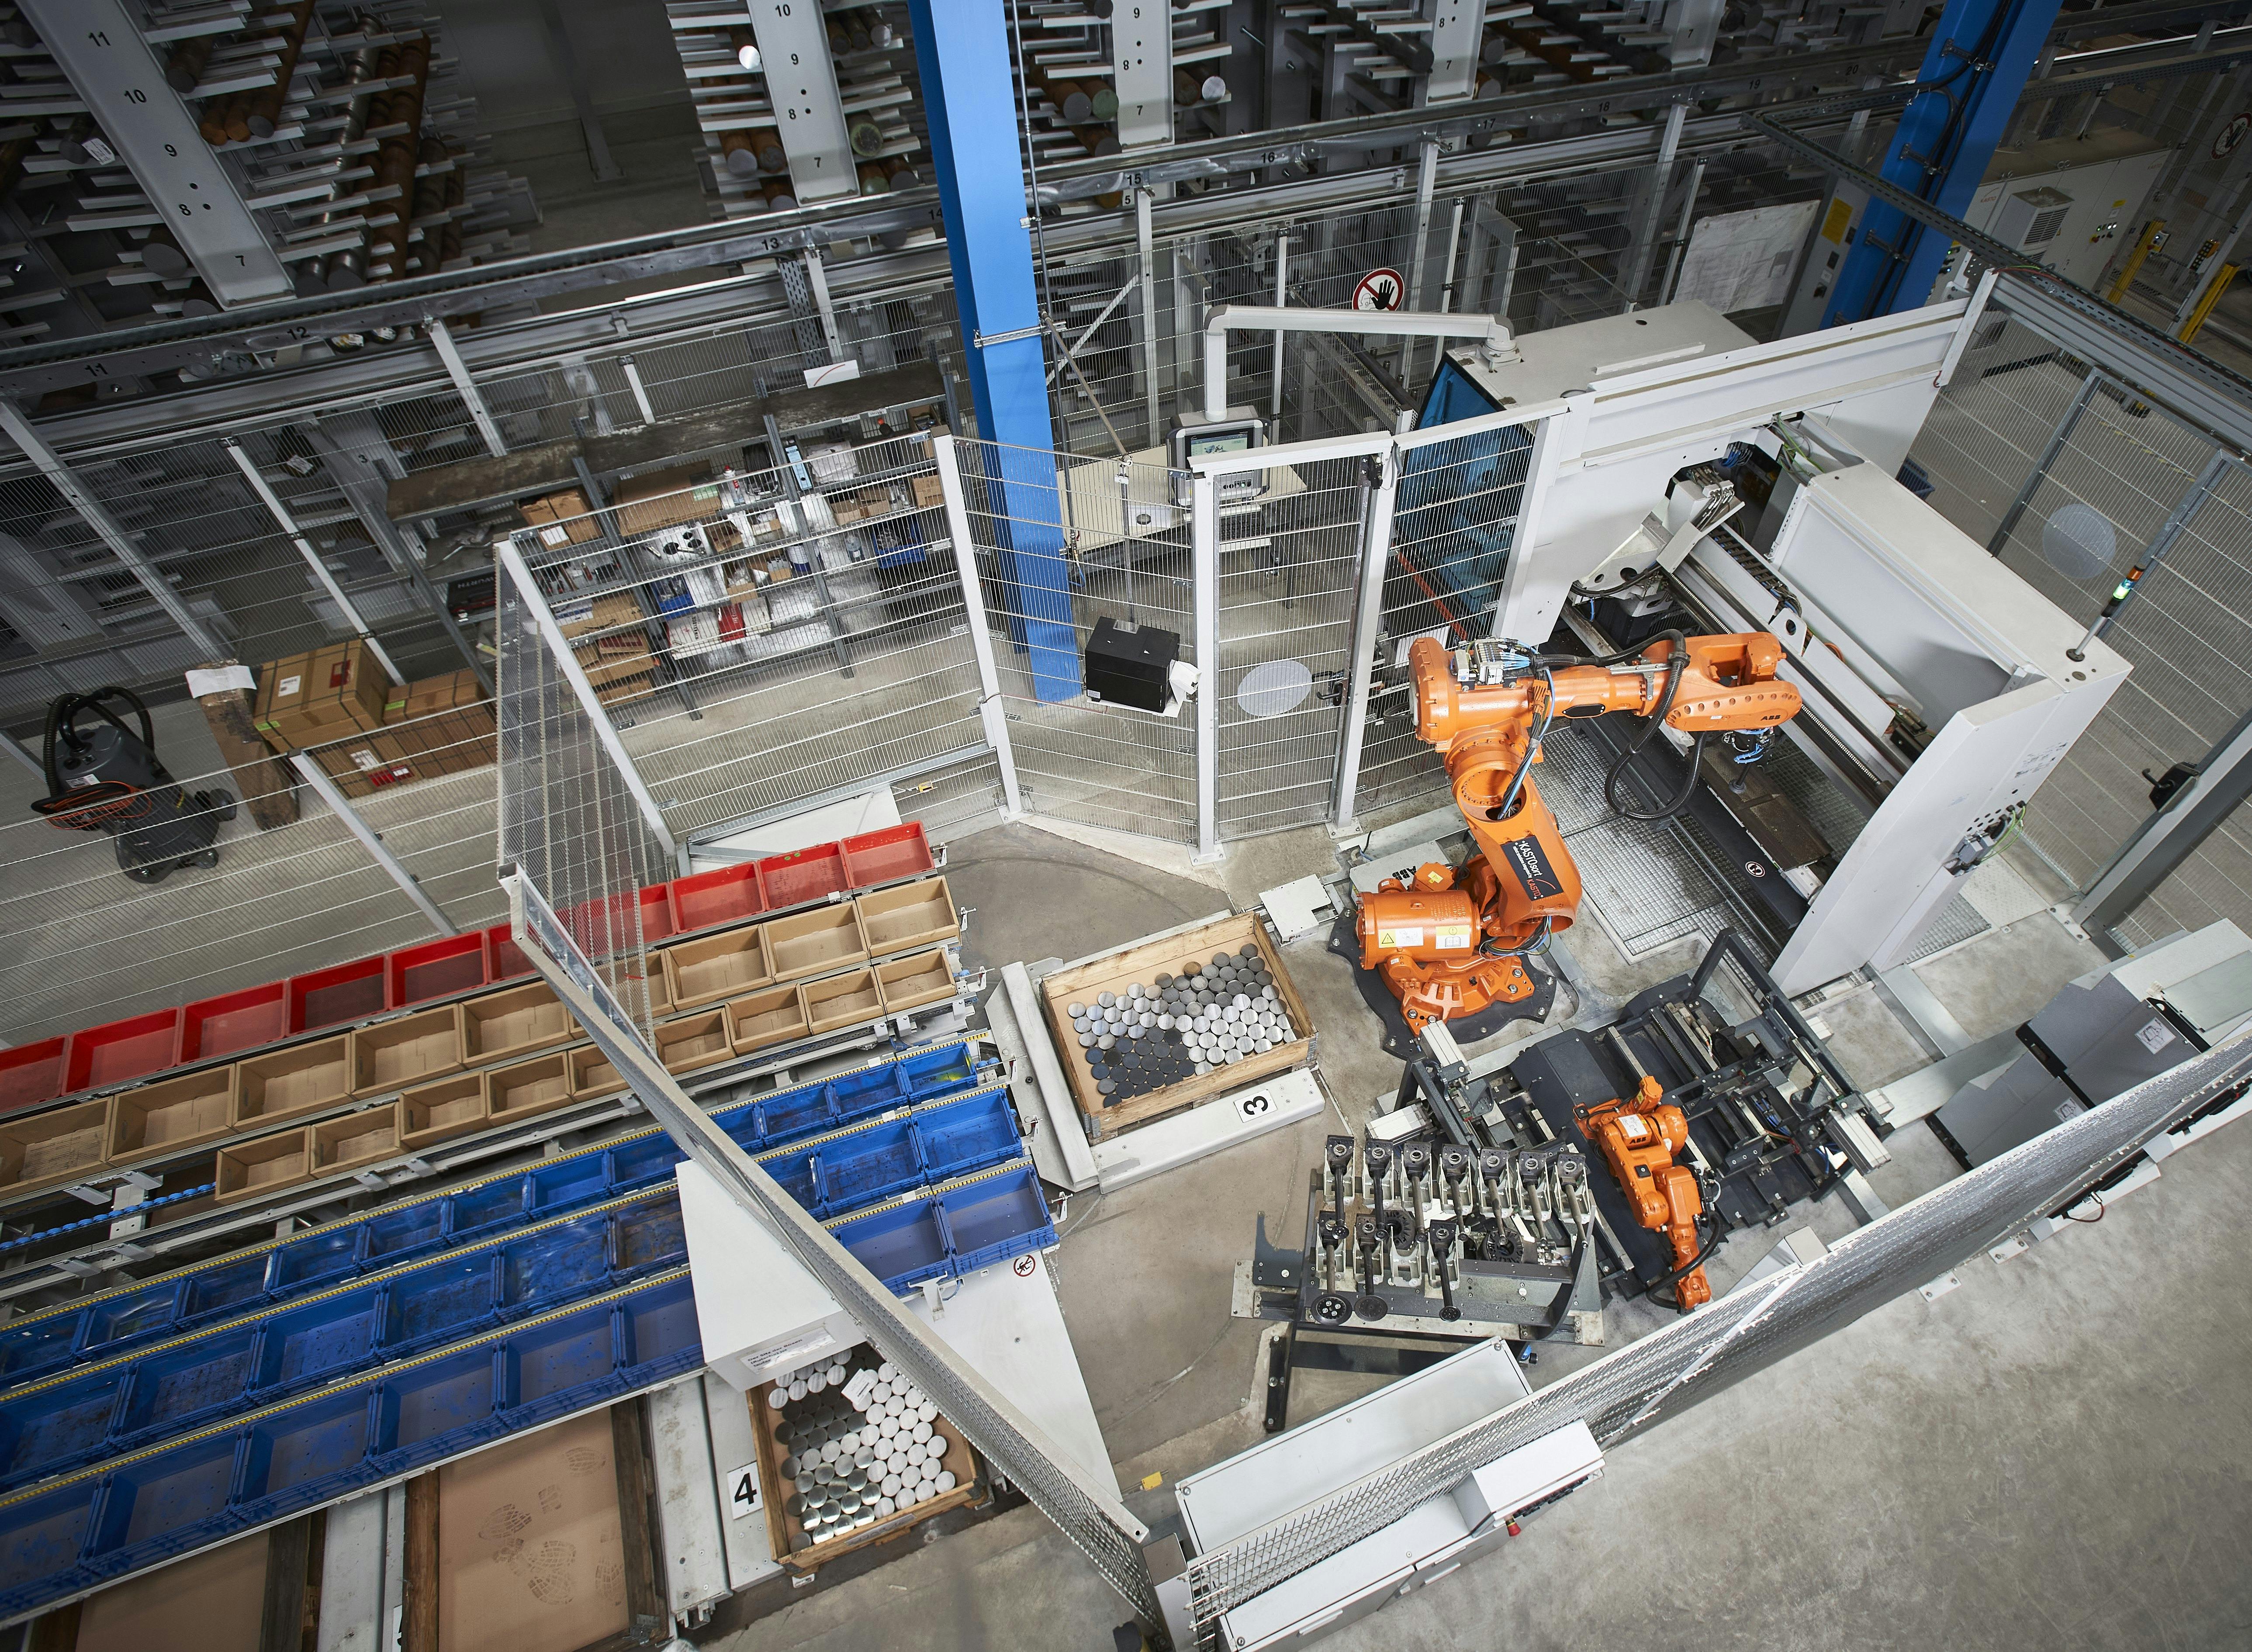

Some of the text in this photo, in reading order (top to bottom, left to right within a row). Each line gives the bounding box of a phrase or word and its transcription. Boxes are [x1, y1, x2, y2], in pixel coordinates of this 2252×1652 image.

[775, 4, 790, 17] 10
[1134, 8, 1140, 18] 9
[1439, 18, 1444, 28] 8
[89, 32, 110, 46] 11
[1688, 29, 1693, 38] 7
[791, 54, 799, 65] 9
[1123, 60, 1129, 70] 8
[1447, 60, 1452, 70] 7
[1844, 64, 1858, 76] 20
[1749, 79, 1760, 89] 19
[124, 90, 146, 104] 10
[1136, 105, 1142, 115] 7
[1598, 101, 1610, 112] 18
[789, 109, 796, 120] 8
[1483, 118, 1495, 130] 17
[165, 144, 177, 156] 9
[814, 157, 821, 168] 7
[1261, 152, 1274, 163] 16
[1127, 173, 1141, 186] 15
[1124, 195, 1130, 204] 5
[179, 204, 191, 215] 8
[928, 207, 942, 220] 14
[761, 237, 779, 251] 13
[235, 256, 245, 266] 7
[287, 327, 310, 340] 12
[84, 363, 107, 376] 11
[358, 454, 367, 463] 3
[1519, 843, 1543, 876] KASTOsort
[1392, 866, 1416, 880] ABB
[1527, 879, 1541, 896] KASTO
[1244, 1096, 1268, 1115] 3
[734, 1473, 757, 1505] 4
